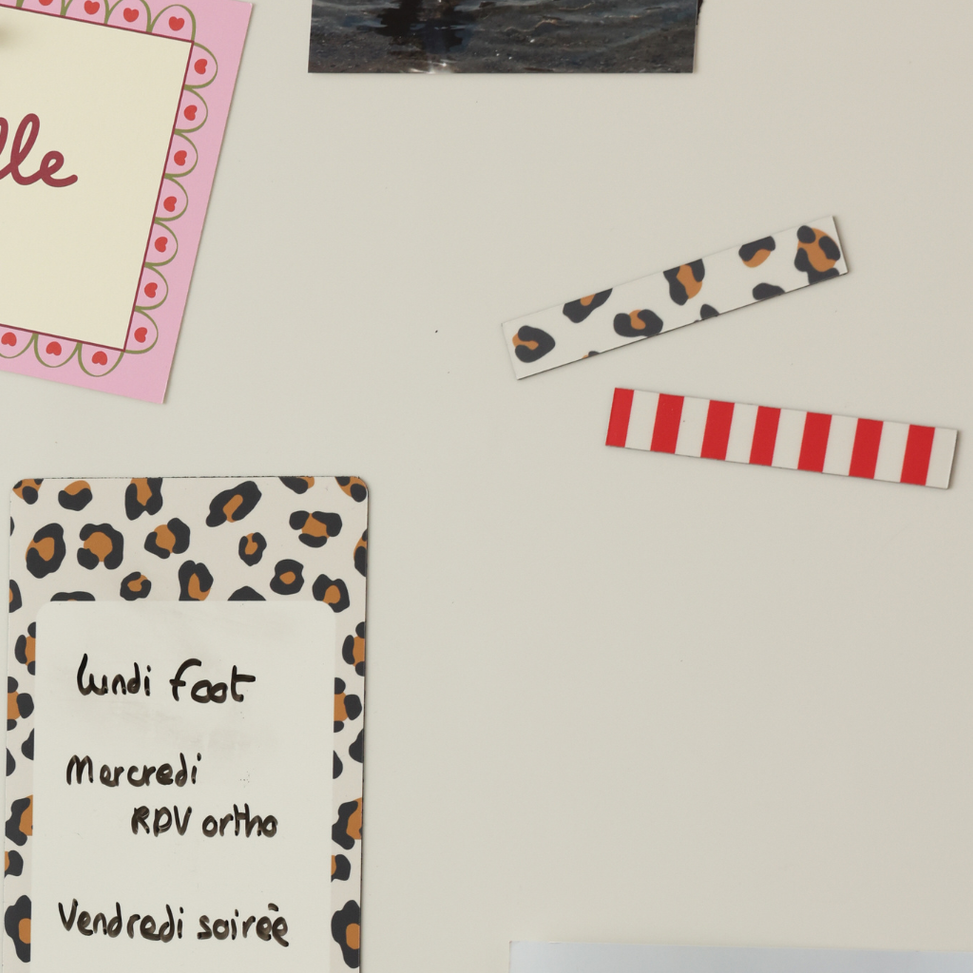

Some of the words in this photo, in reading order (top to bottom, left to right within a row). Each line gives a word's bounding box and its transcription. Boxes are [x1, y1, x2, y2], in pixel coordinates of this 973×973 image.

[65, 752, 203, 788] Mercredi
[130, 805, 193, 837] RDV
[201, 803, 279, 839] ortho
[57, 898, 185, 944] Vendredi
